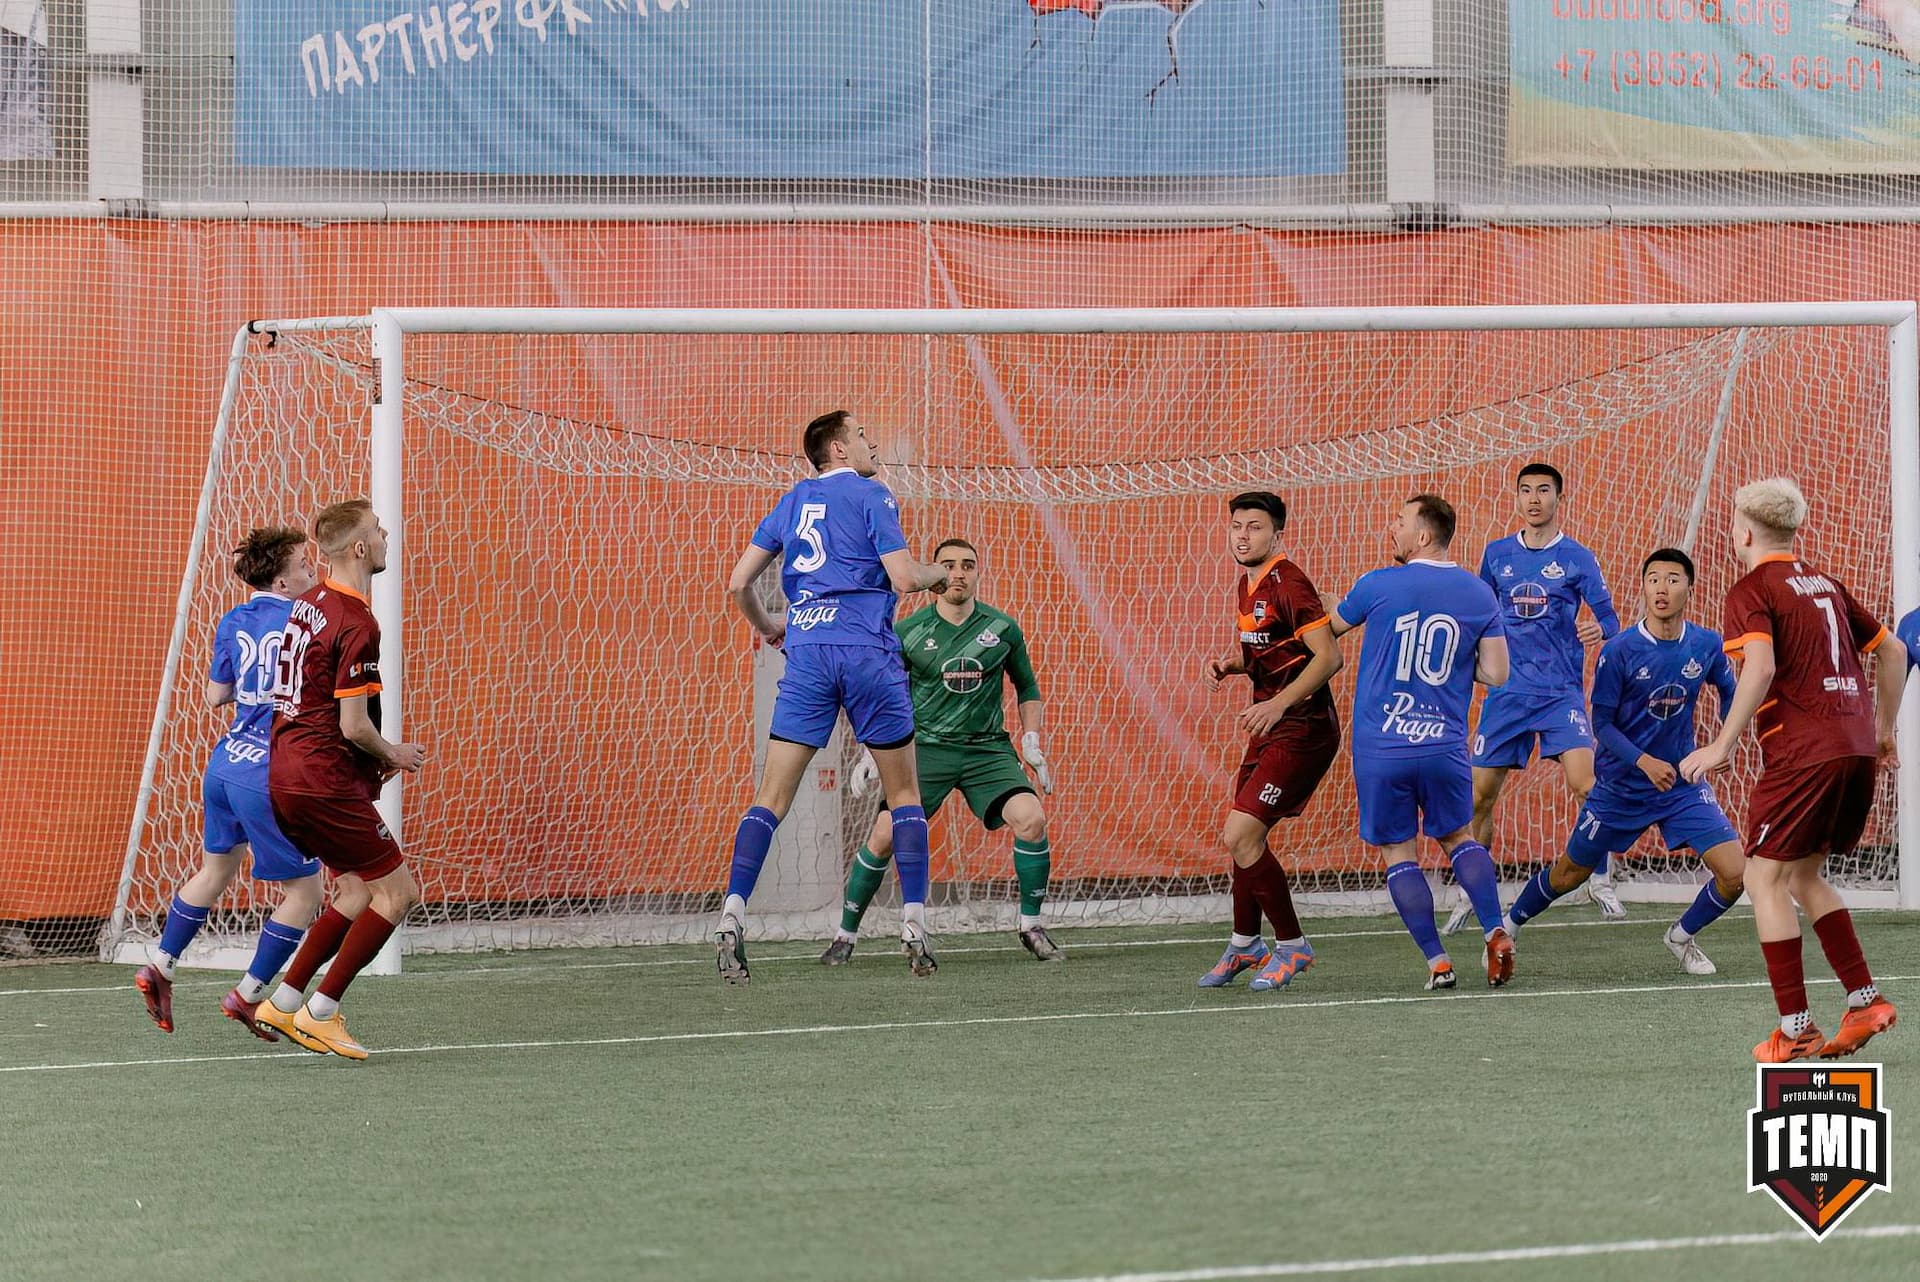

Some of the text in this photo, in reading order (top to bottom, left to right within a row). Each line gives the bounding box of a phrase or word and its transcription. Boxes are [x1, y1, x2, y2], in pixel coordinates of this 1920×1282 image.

[301, 1, 500, 98] ПАРТНЕР
[1554, 48, 1596, 84] +7
[1609, 49, 1721, 95] (3852)
[791, 503, 827, 573] 5
[236, 629, 285, 705] 20
[363, 662, 381, 672] ПС
[1394, 610, 1461, 686] 10
[1382, 691, 1446, 744] Praga
[1258, 782, 1282, 805] 22
[1579, 810, 1601, 840] 71
